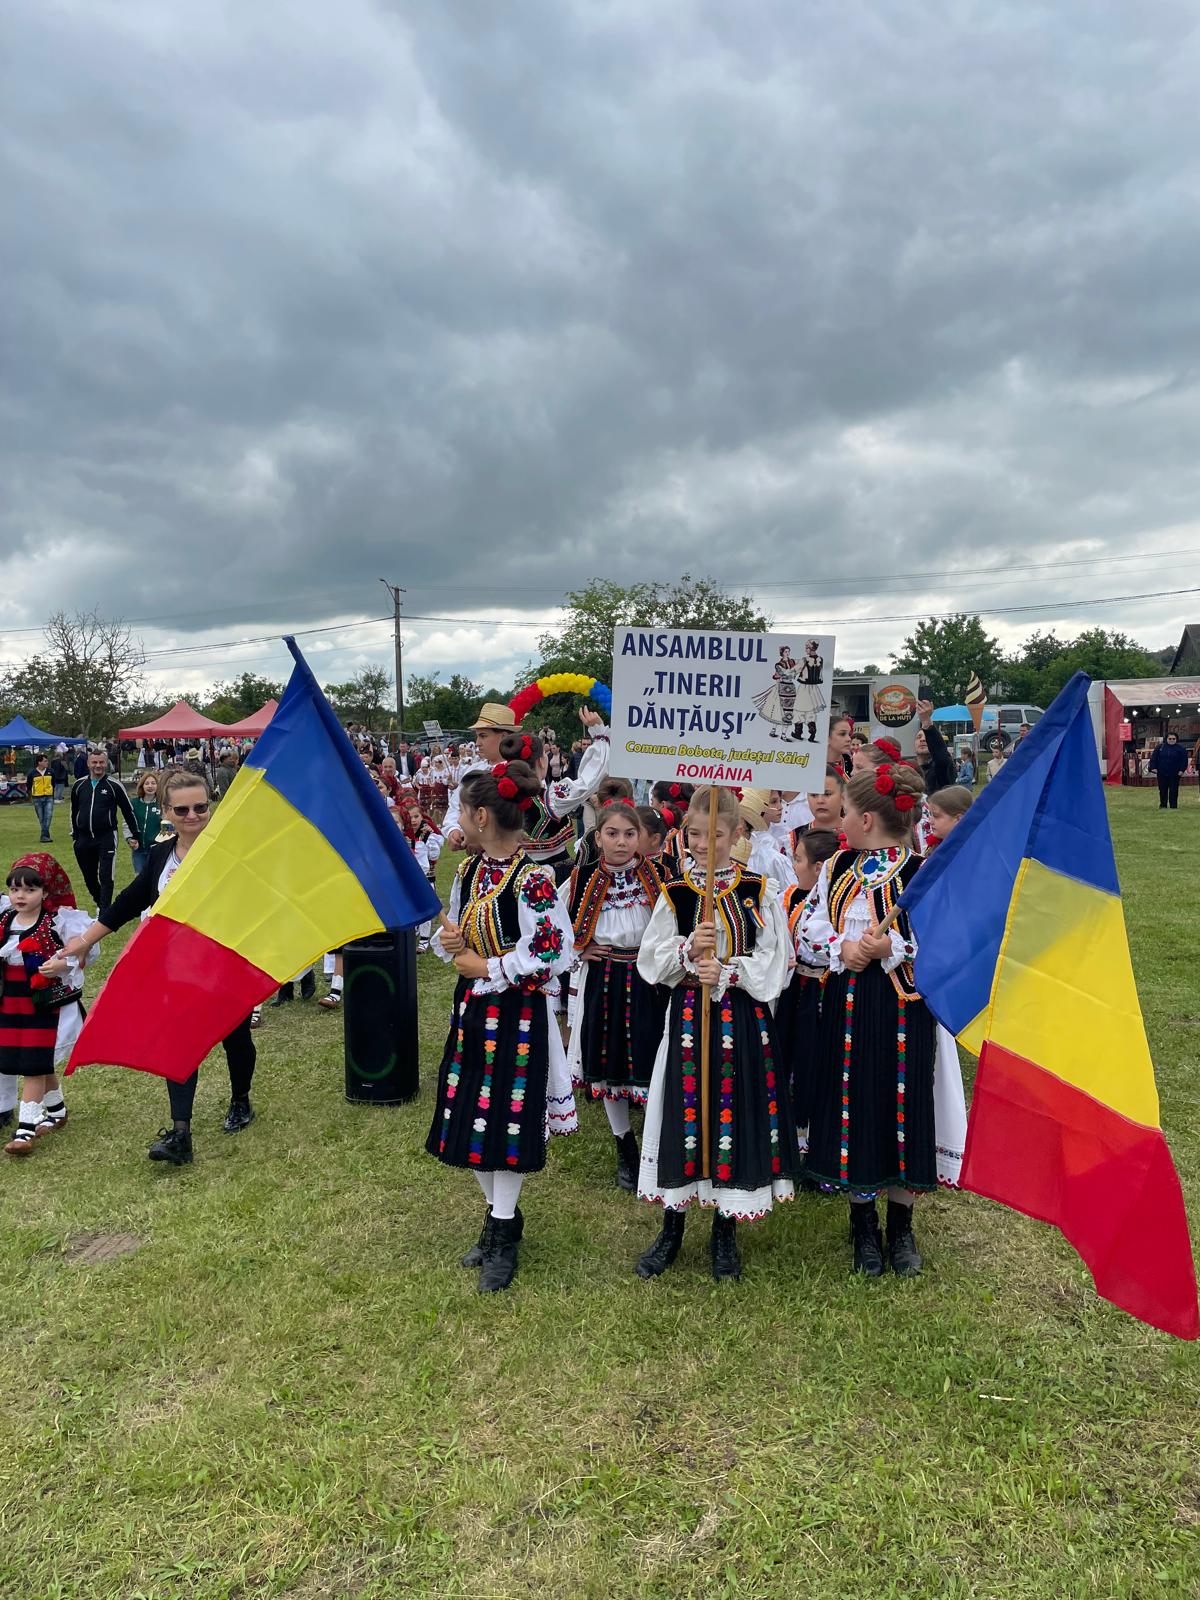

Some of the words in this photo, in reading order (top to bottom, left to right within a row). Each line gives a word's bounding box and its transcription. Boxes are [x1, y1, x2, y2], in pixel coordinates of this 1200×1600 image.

[621, 632, 768, 663] ANSAMBLUL
[643, 671, 741, 698] „TINERII
[625, 740, 676, 756] Comuna
[677, 744, 727, 760] Bobota,
[676, 763, 753, 782] ROMÂNIA
